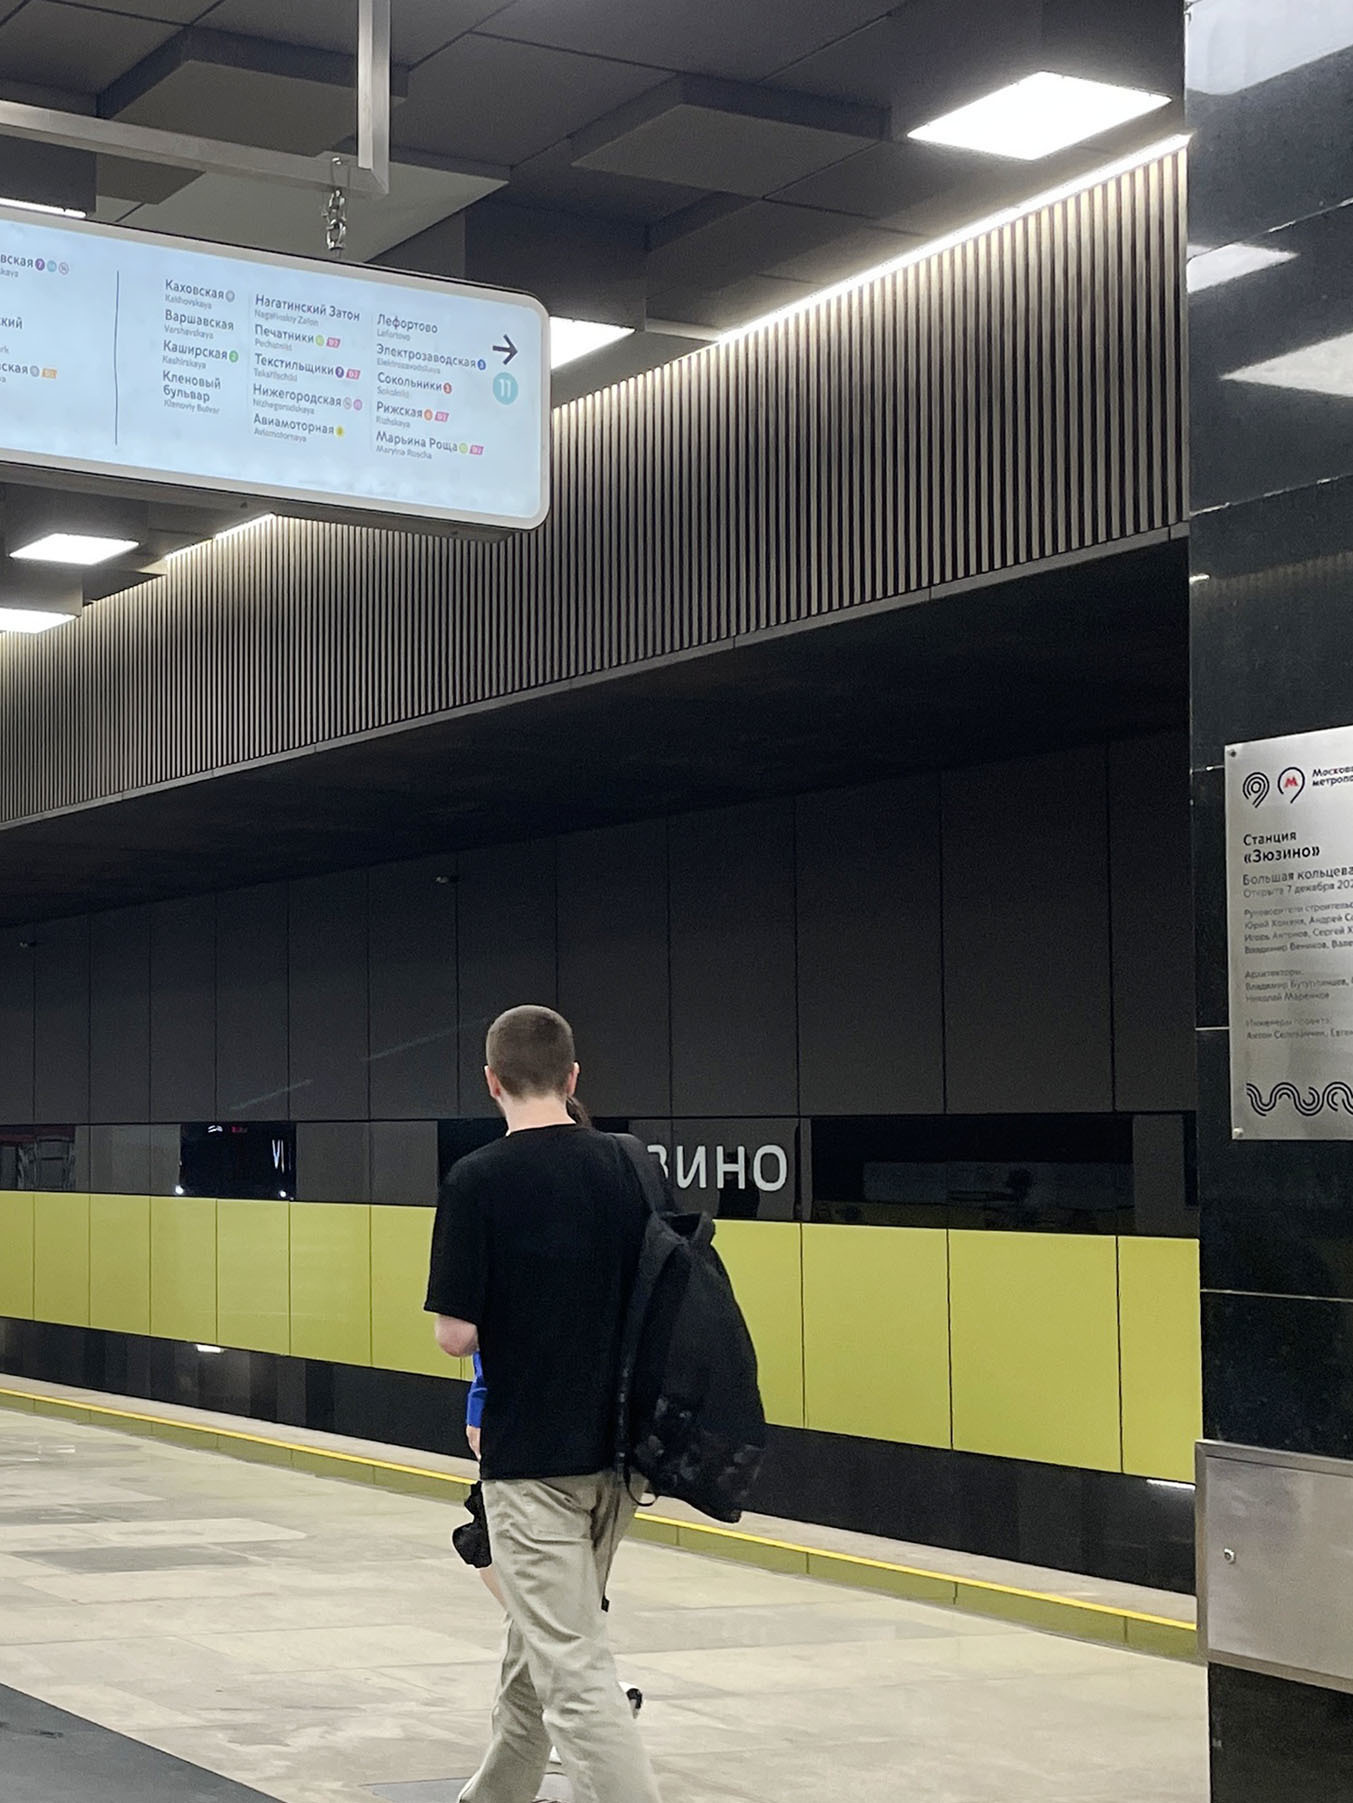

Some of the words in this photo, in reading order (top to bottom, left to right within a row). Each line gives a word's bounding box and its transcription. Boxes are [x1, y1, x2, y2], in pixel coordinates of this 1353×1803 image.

[165, 279, 225, 300] Каховская
[255, 294, 327, 316] Нагатинский
[328, 305, 361, 322] Затон
[165, 309, 234, 330] Варшавская
[377, 314, 438, 334] Лефортово
[254, 324, 314, 344] Печатники
[163, 339, 228, 360] Каширская
[377, 343, 476, 368] Электрозаводская
[254, 353, 334, 376] Текстильщики
[162, 370, 221, 390] Кленовый
[377, 371, 442, 391] Сокольники
[499, 378, 511, 399] 11
[163, 385, 210, 404] бульвар
[253, 383, 342, 407] Нижегородская
[376, 401, 423, 418] Рижская
[253, 413, 335, 435] Авиамоторная
[376, 430, 426, 448] Марьина
[429, 437, 458, 453] Роща
[1312, 766, 1353, 778] Москов
[1243, 832, 1297, 846] Станция
[1244, 846, 1320, 864] «Зюзино»
[1243, 872, 1294, 886] Большая
[1243, 887, 1284, 898] Открыта
[1286, 885, 1292, 894] 7
[1294, 881, 1335, 895] декабря
[647, 1144, 788, 1192] ЗИНО
